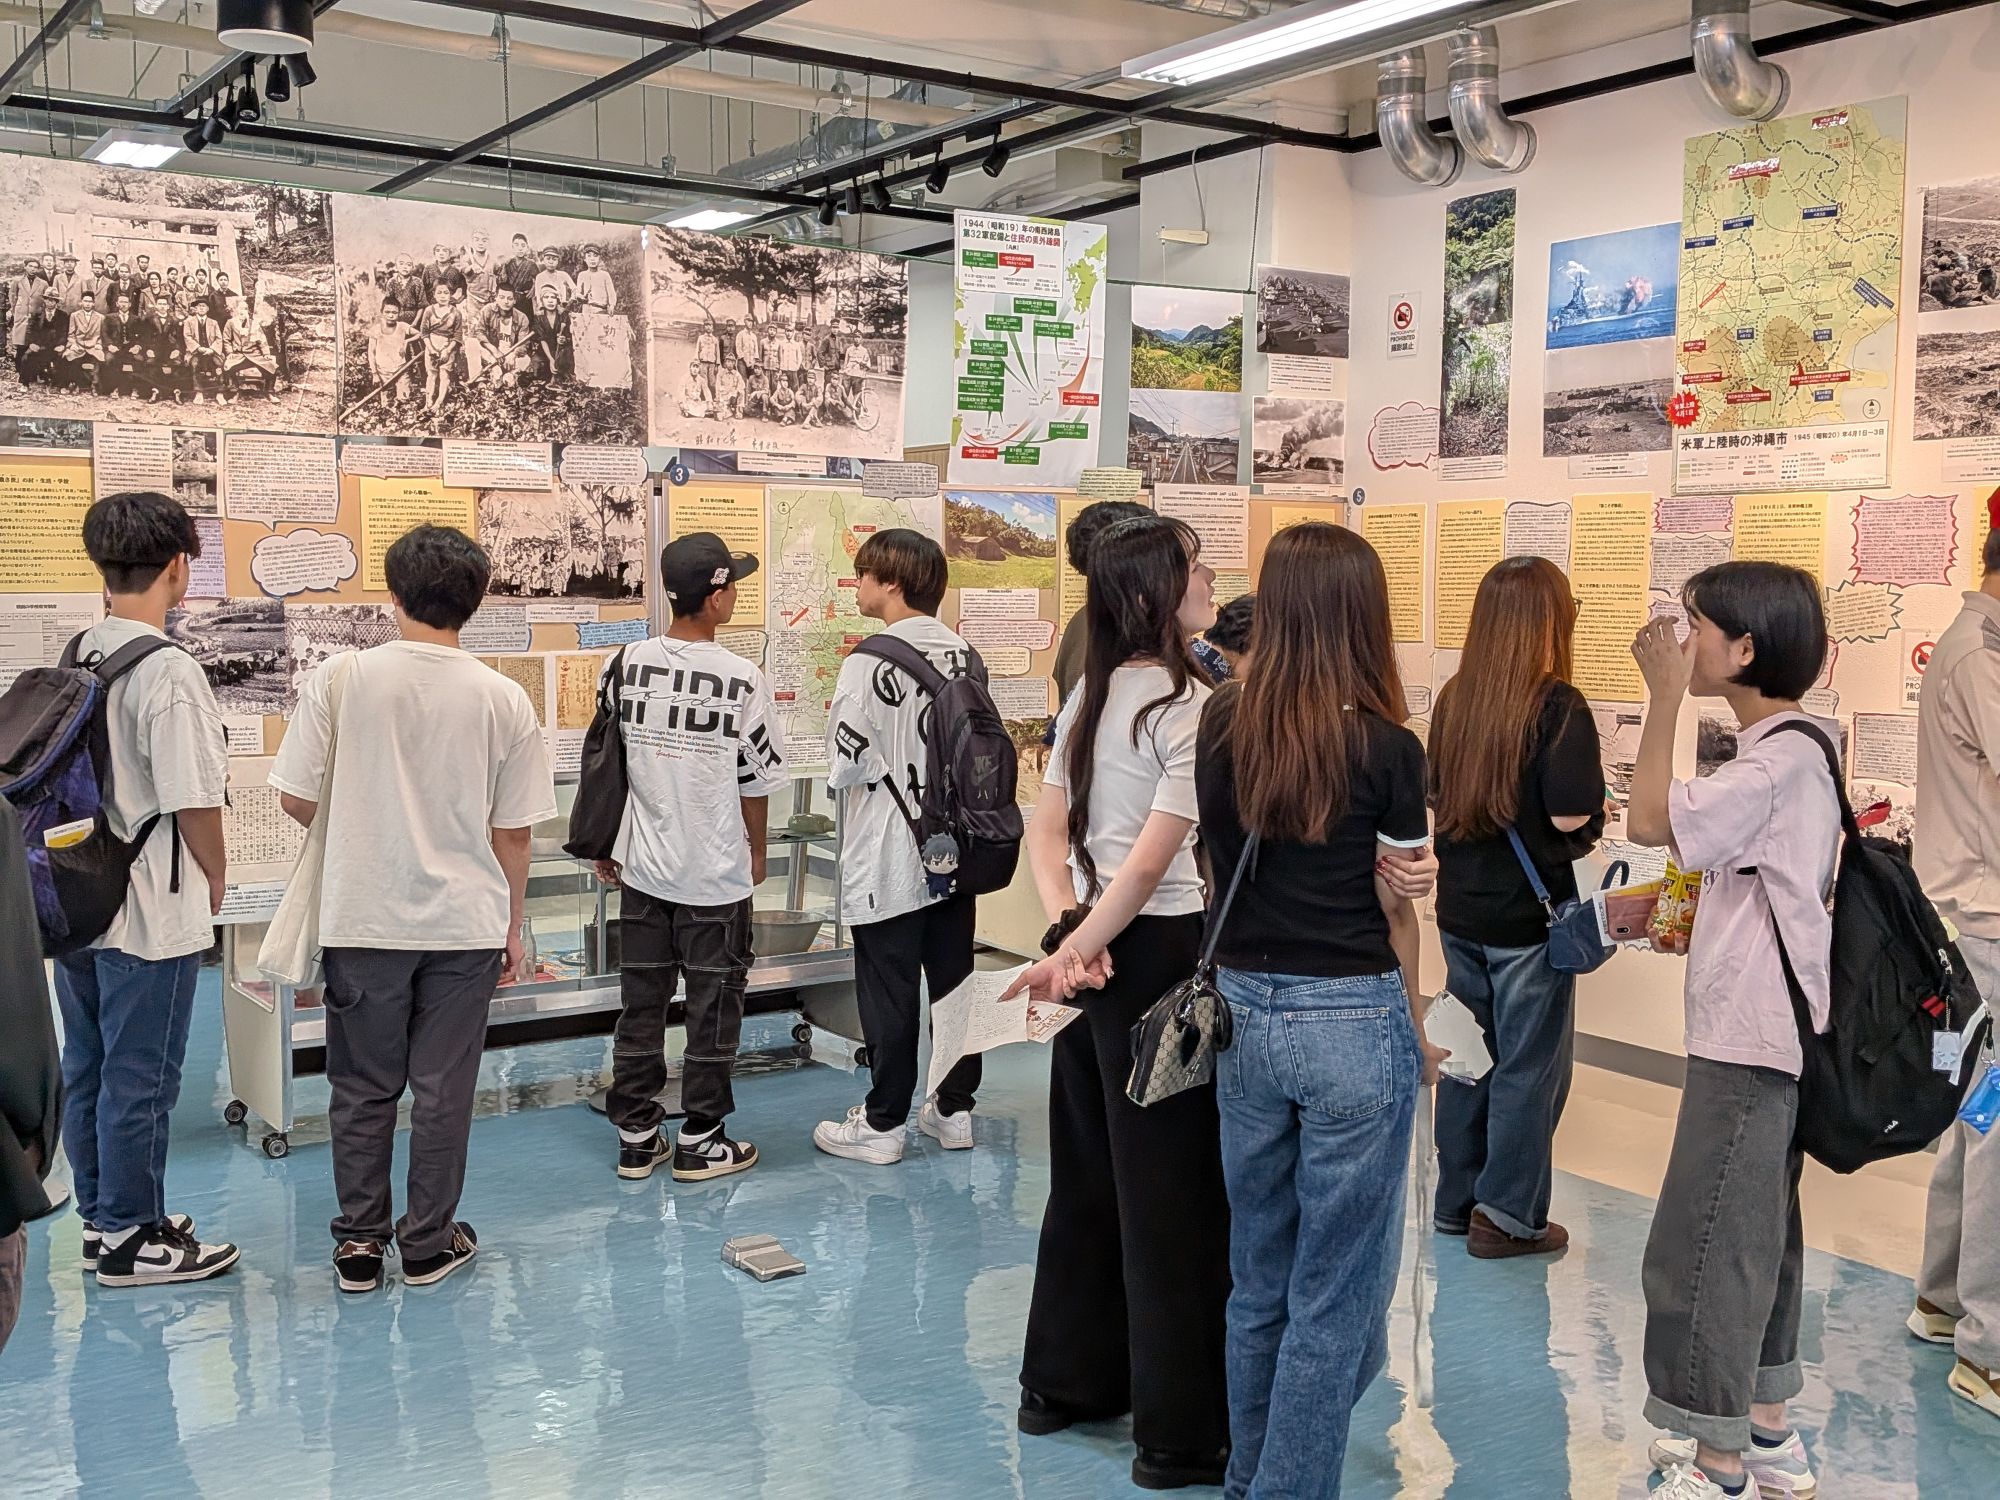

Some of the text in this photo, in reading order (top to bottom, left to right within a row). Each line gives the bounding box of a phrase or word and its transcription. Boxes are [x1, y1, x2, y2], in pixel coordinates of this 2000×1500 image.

[1390, 334, 1416, 342] PROHIBITED
[1680, 432, 1788, 451] 米軍上陸時の沖縄市
[675, 468, 683, 481] 3
[1356, 491, 1363, 503] 5
[1883, 1119, 1899, 1133] FILA
